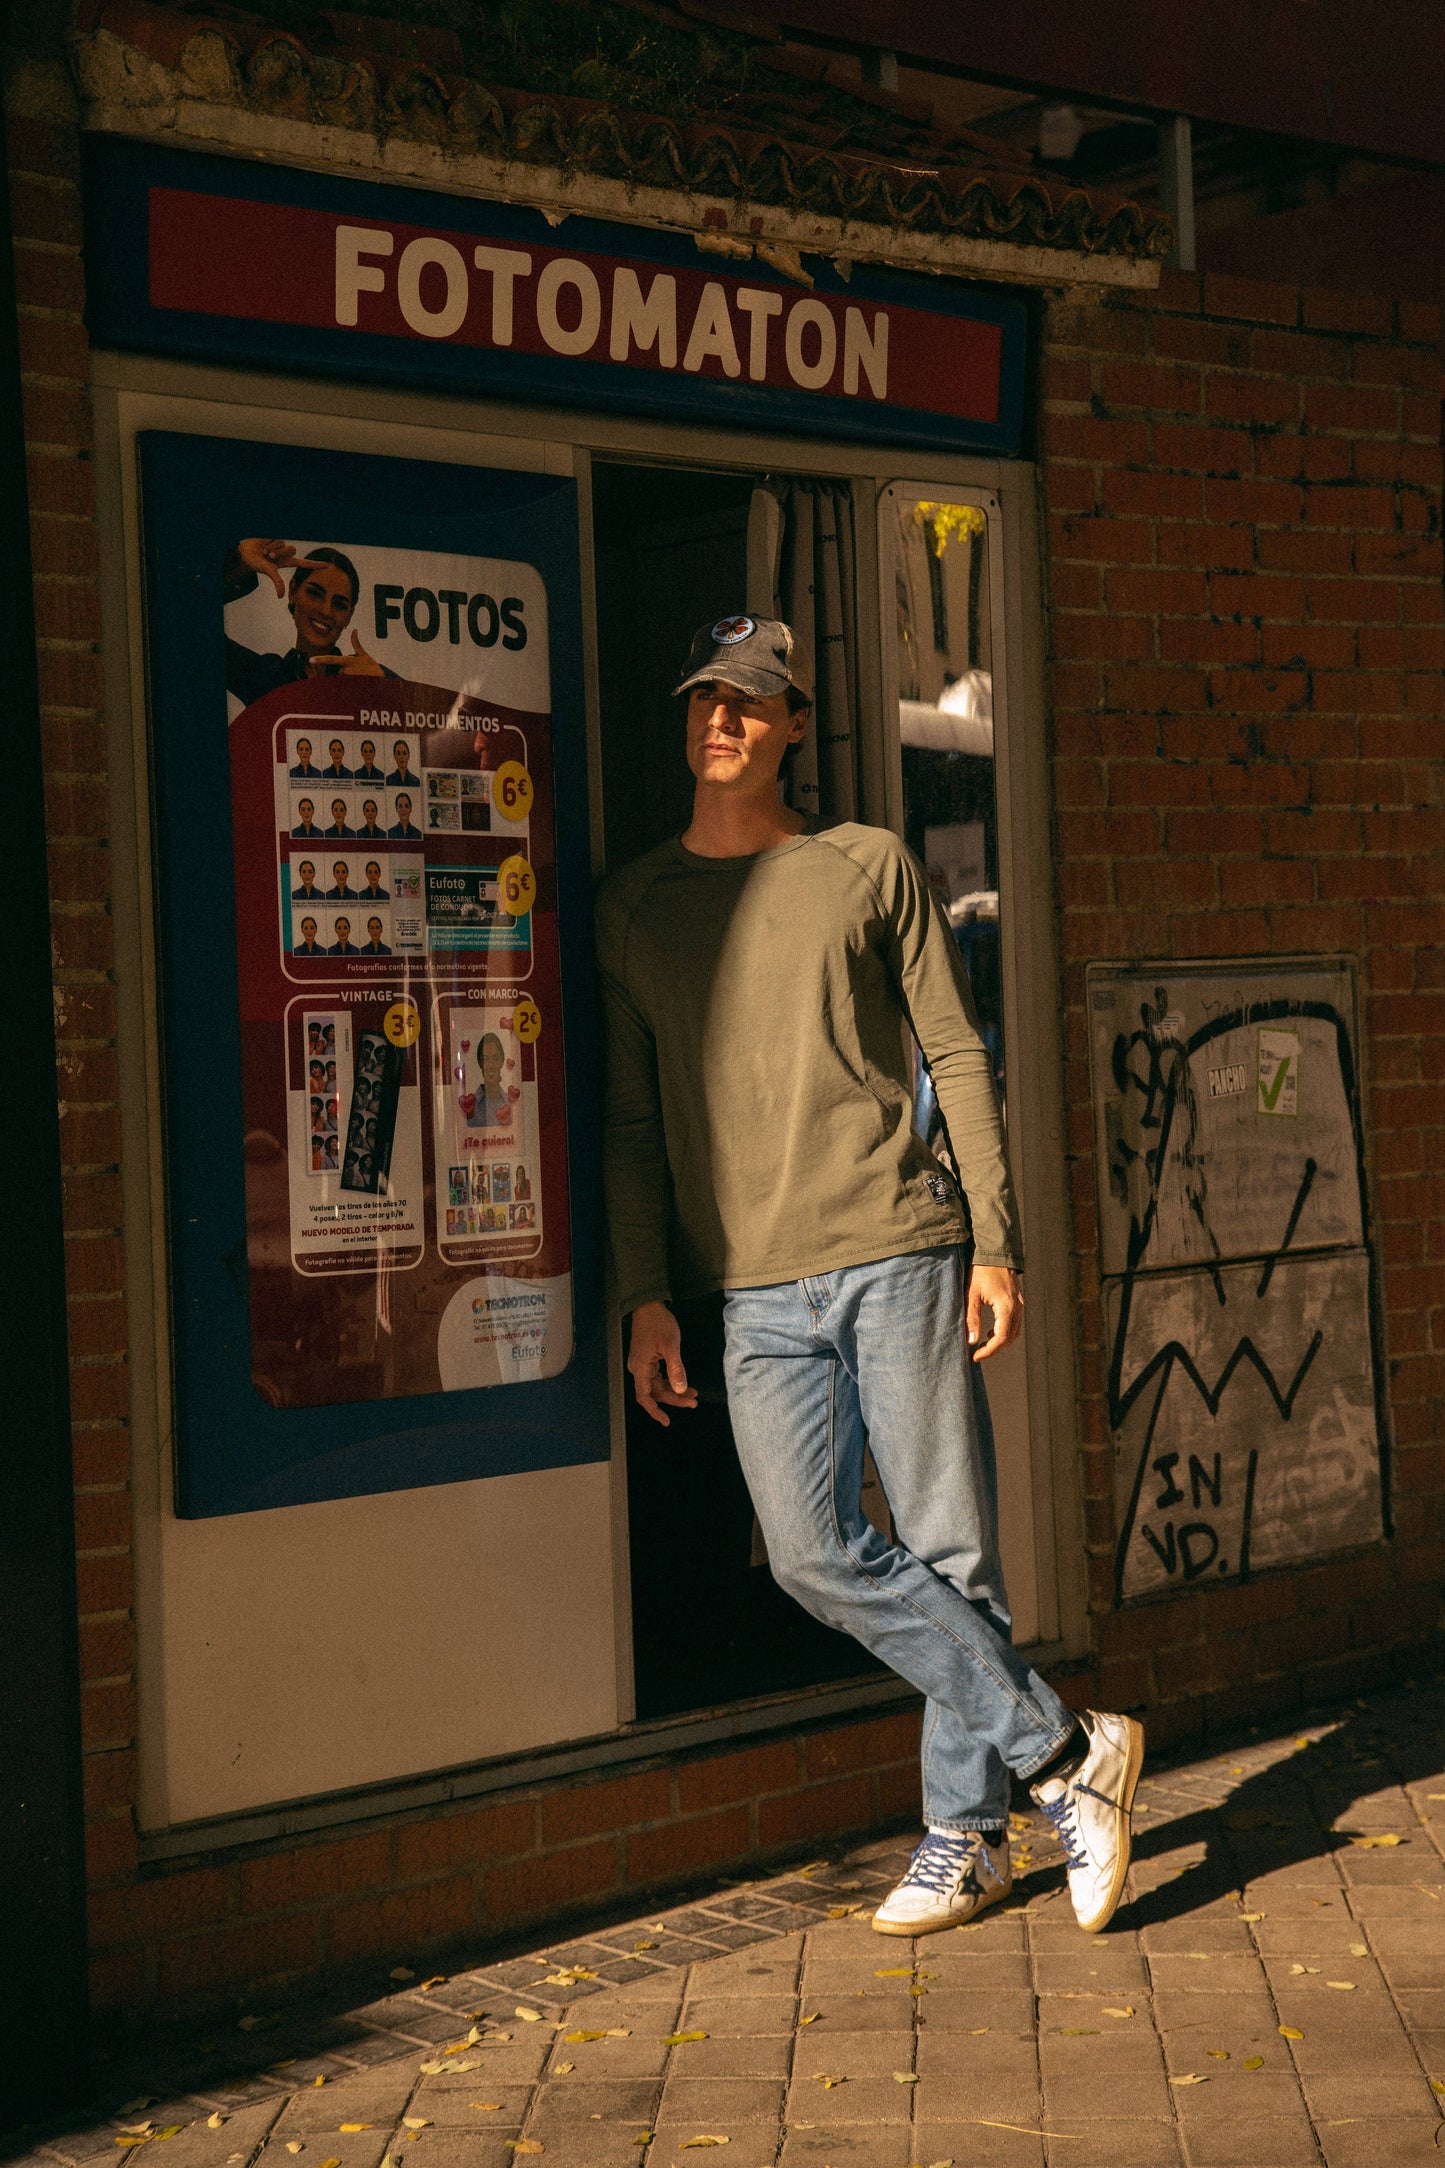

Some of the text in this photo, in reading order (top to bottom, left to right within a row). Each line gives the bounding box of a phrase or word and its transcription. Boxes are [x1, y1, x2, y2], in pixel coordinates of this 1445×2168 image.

[335, 223, 890, 401] FOTOMATON
[374, 584, 528, 651] FOTOS
[360, 709, 500, 733] PARA DOCUMENTOS
[502, 777, 528, 806] 6€
[430, 877, 466, 889] Eufoto
[505, 872, 530, 901] 6€
[430, 895, 451, 903] FOTOS
[347, 963, 387, 973] Fotografías
[388, 963, 423, 971] conformes
[436, 963, 467, 971] normativa
[340, 990, 393, 1002] VINTAGE
[468, 988, 519, 1000] CON MARCO
[392, 1014, 414, 1036] 3€
[519, 1011, 538, 1033] 2€
[1208, 1064, 1246, 1097] PANCHO
[481, 1135, 515, 1150] quiero!
[347, 1202, 362, 1210] tiras
[385, 1212, 390, 1220] y
[302, 1229, 328, 1237] NUEVO
[330, 1227, 360, 1236] MODELO
[372, 1223, 415, 1233] TEMPORADA
[305, 1257, 337, 1267] Fotografía
[485, 1293, 546, 1311] TECNOTRON
[512, 1344, 548, 1359] Eufoto
[1152, 1450, 1221, 1509] IN
